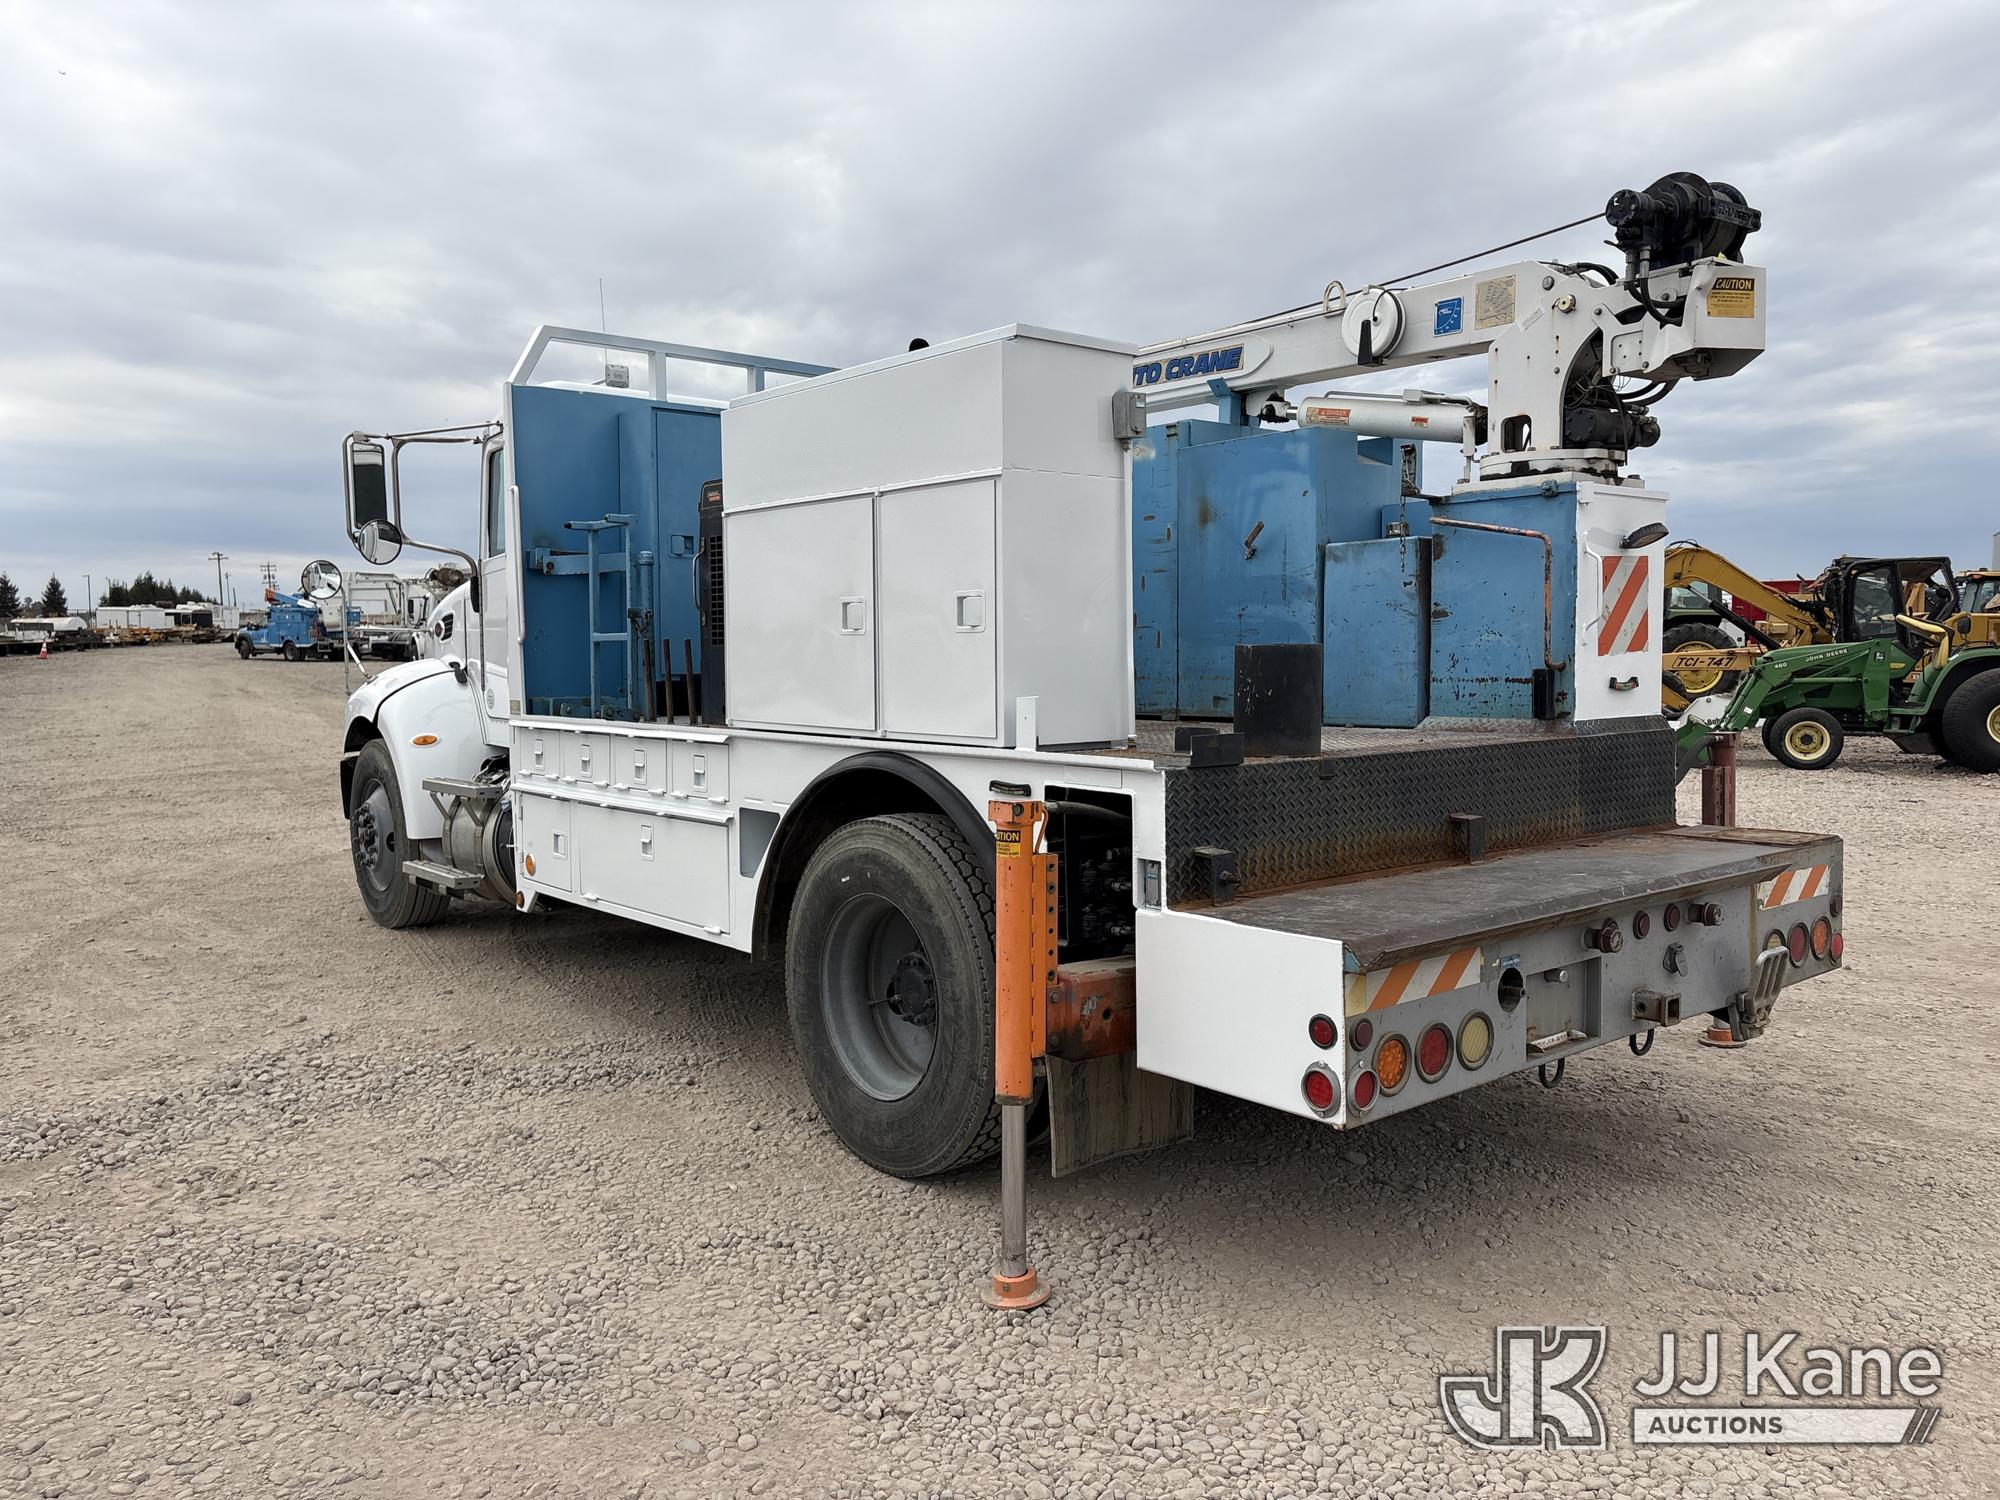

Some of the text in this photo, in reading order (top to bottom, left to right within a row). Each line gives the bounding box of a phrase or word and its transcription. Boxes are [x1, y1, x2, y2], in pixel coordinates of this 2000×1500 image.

[1715, 279, 1752, 290] CAUTION
[1134, 347, 1242, 385] TO CRANE
[1805, 647, 1849, 663] JOHN DEERE
[1677, 656, 1735, 667] TCI-747
[995, 831, 1020, 842] UTION
